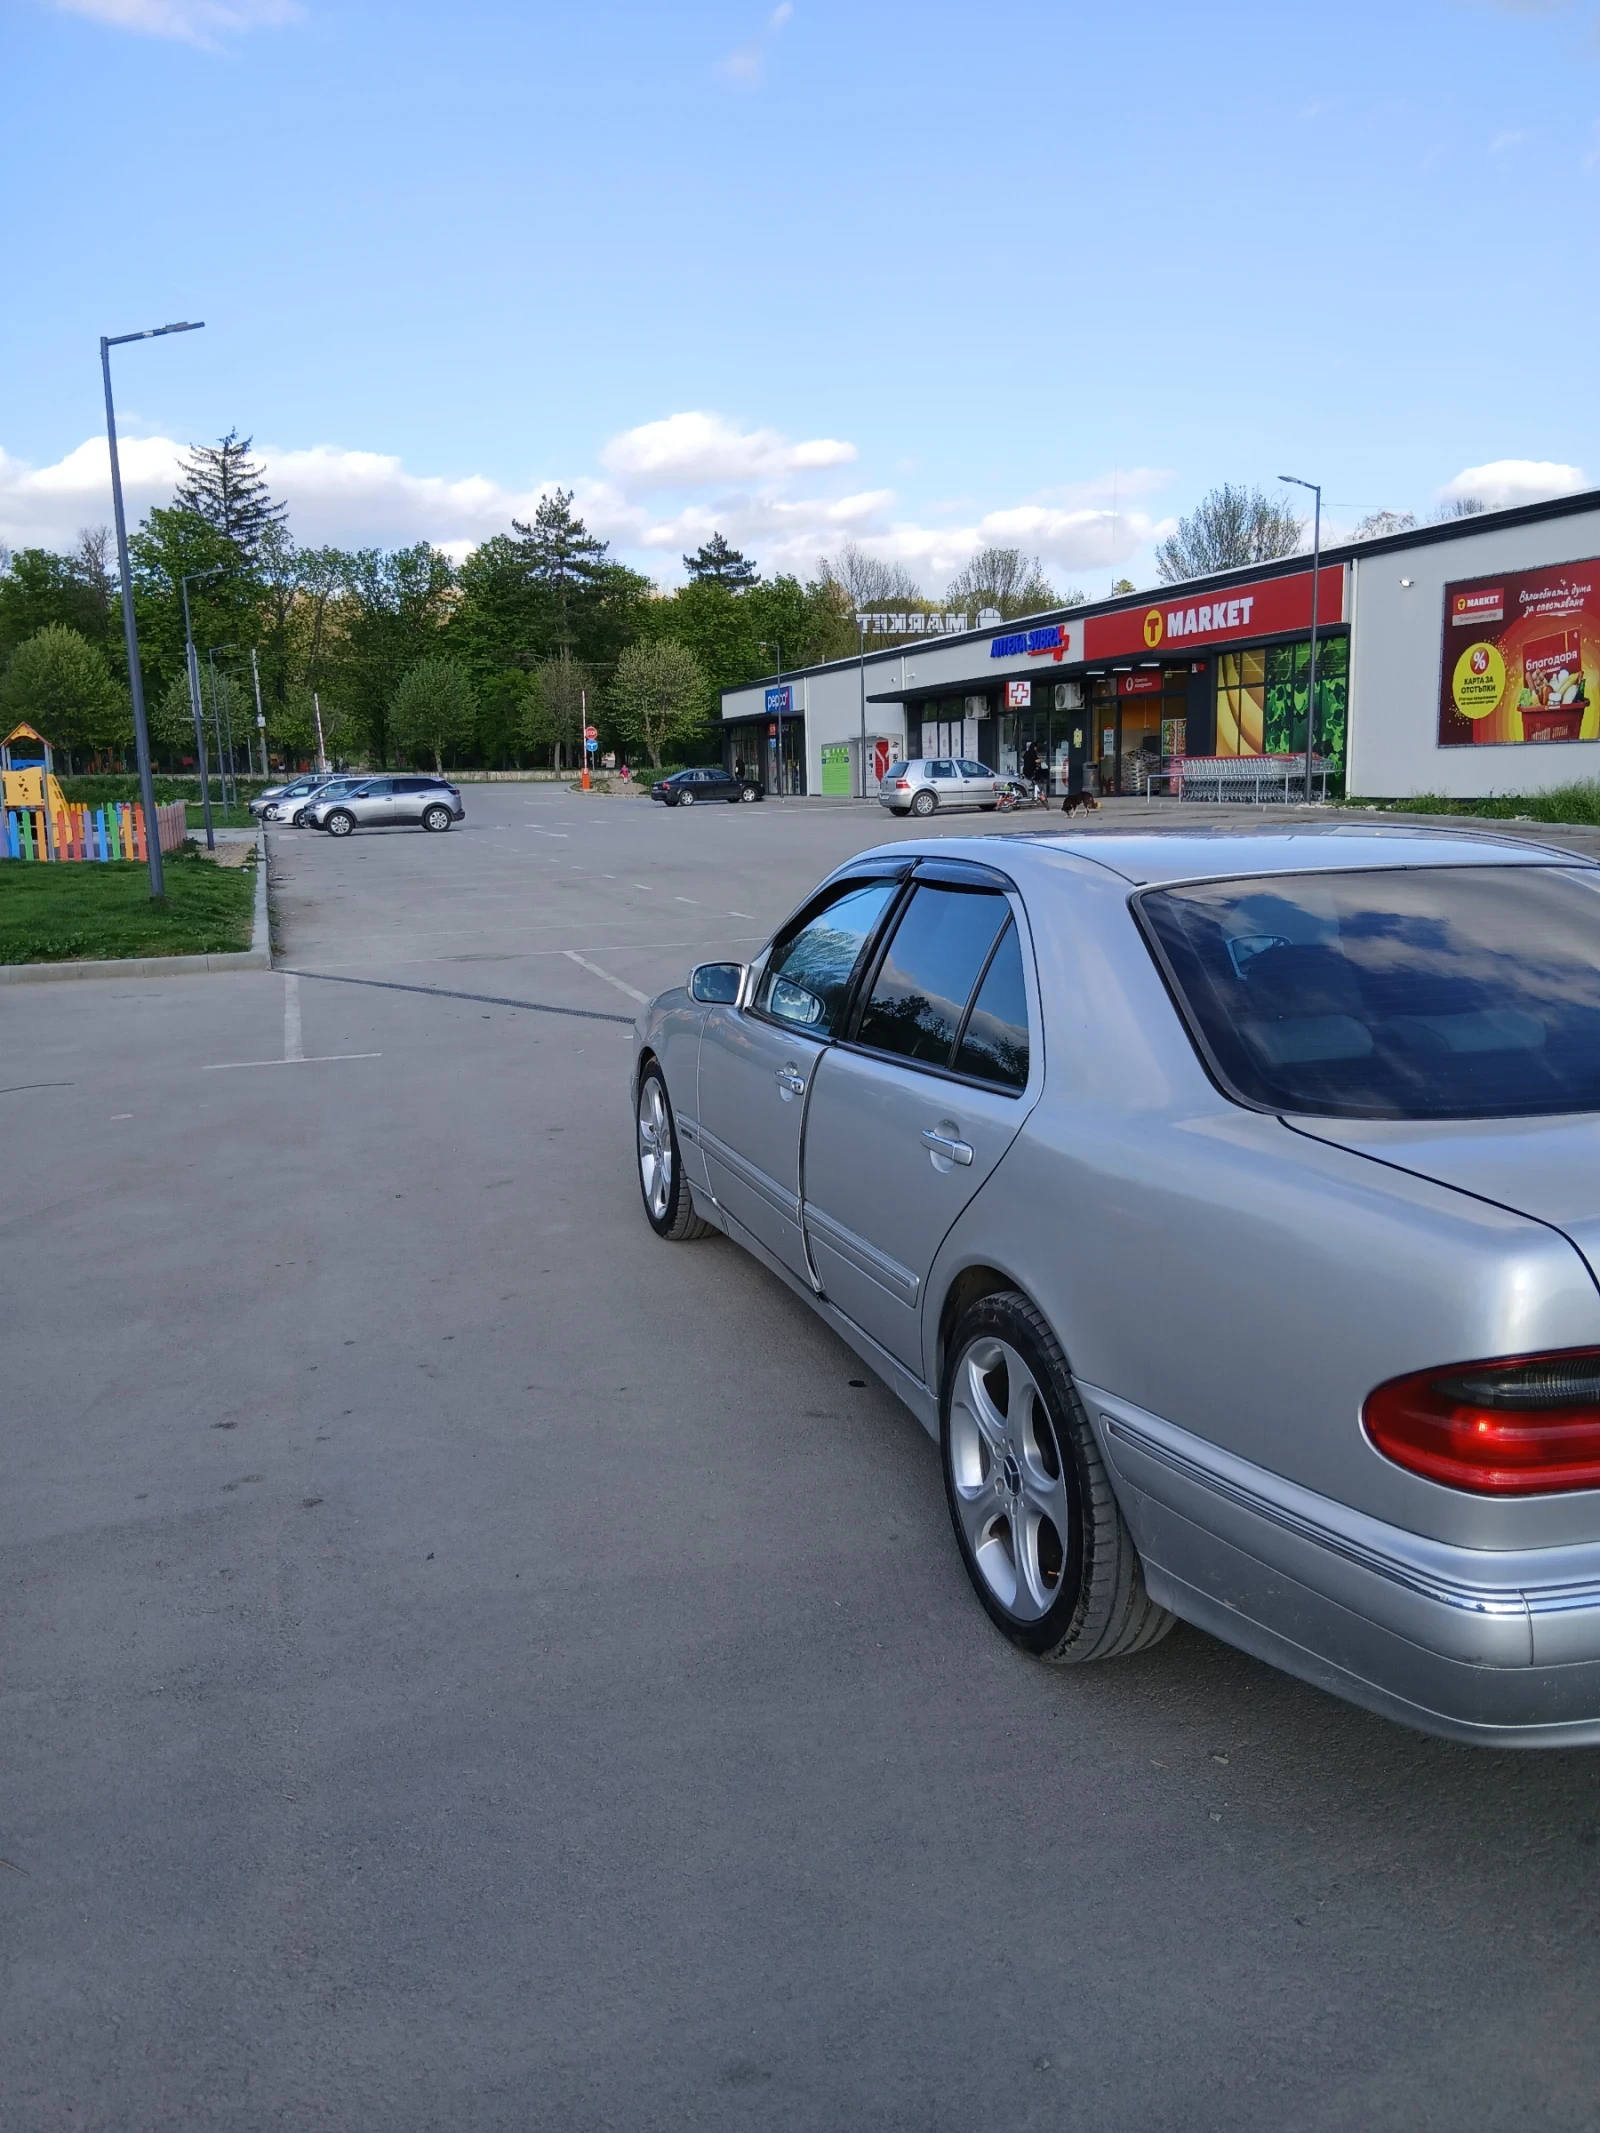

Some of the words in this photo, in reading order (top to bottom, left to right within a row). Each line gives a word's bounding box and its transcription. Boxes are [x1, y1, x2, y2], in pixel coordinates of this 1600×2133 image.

[1572, 583, 1592, 597] дума
[1467, 595, 1499, 608] MARKET
[1167, 597, 1254, 638] MARKET
[1523, 605, 1535, 618] за
[1028, 626, 1062, 651] SUBRA
[1525, 650, 1578, 671] благодаря
[1464, 677, 1484, 685] КАРТА
[1485, 675, 1494, 684] ЗА
[1461, 685, 1496, 694] ОТСТЪПКИ
